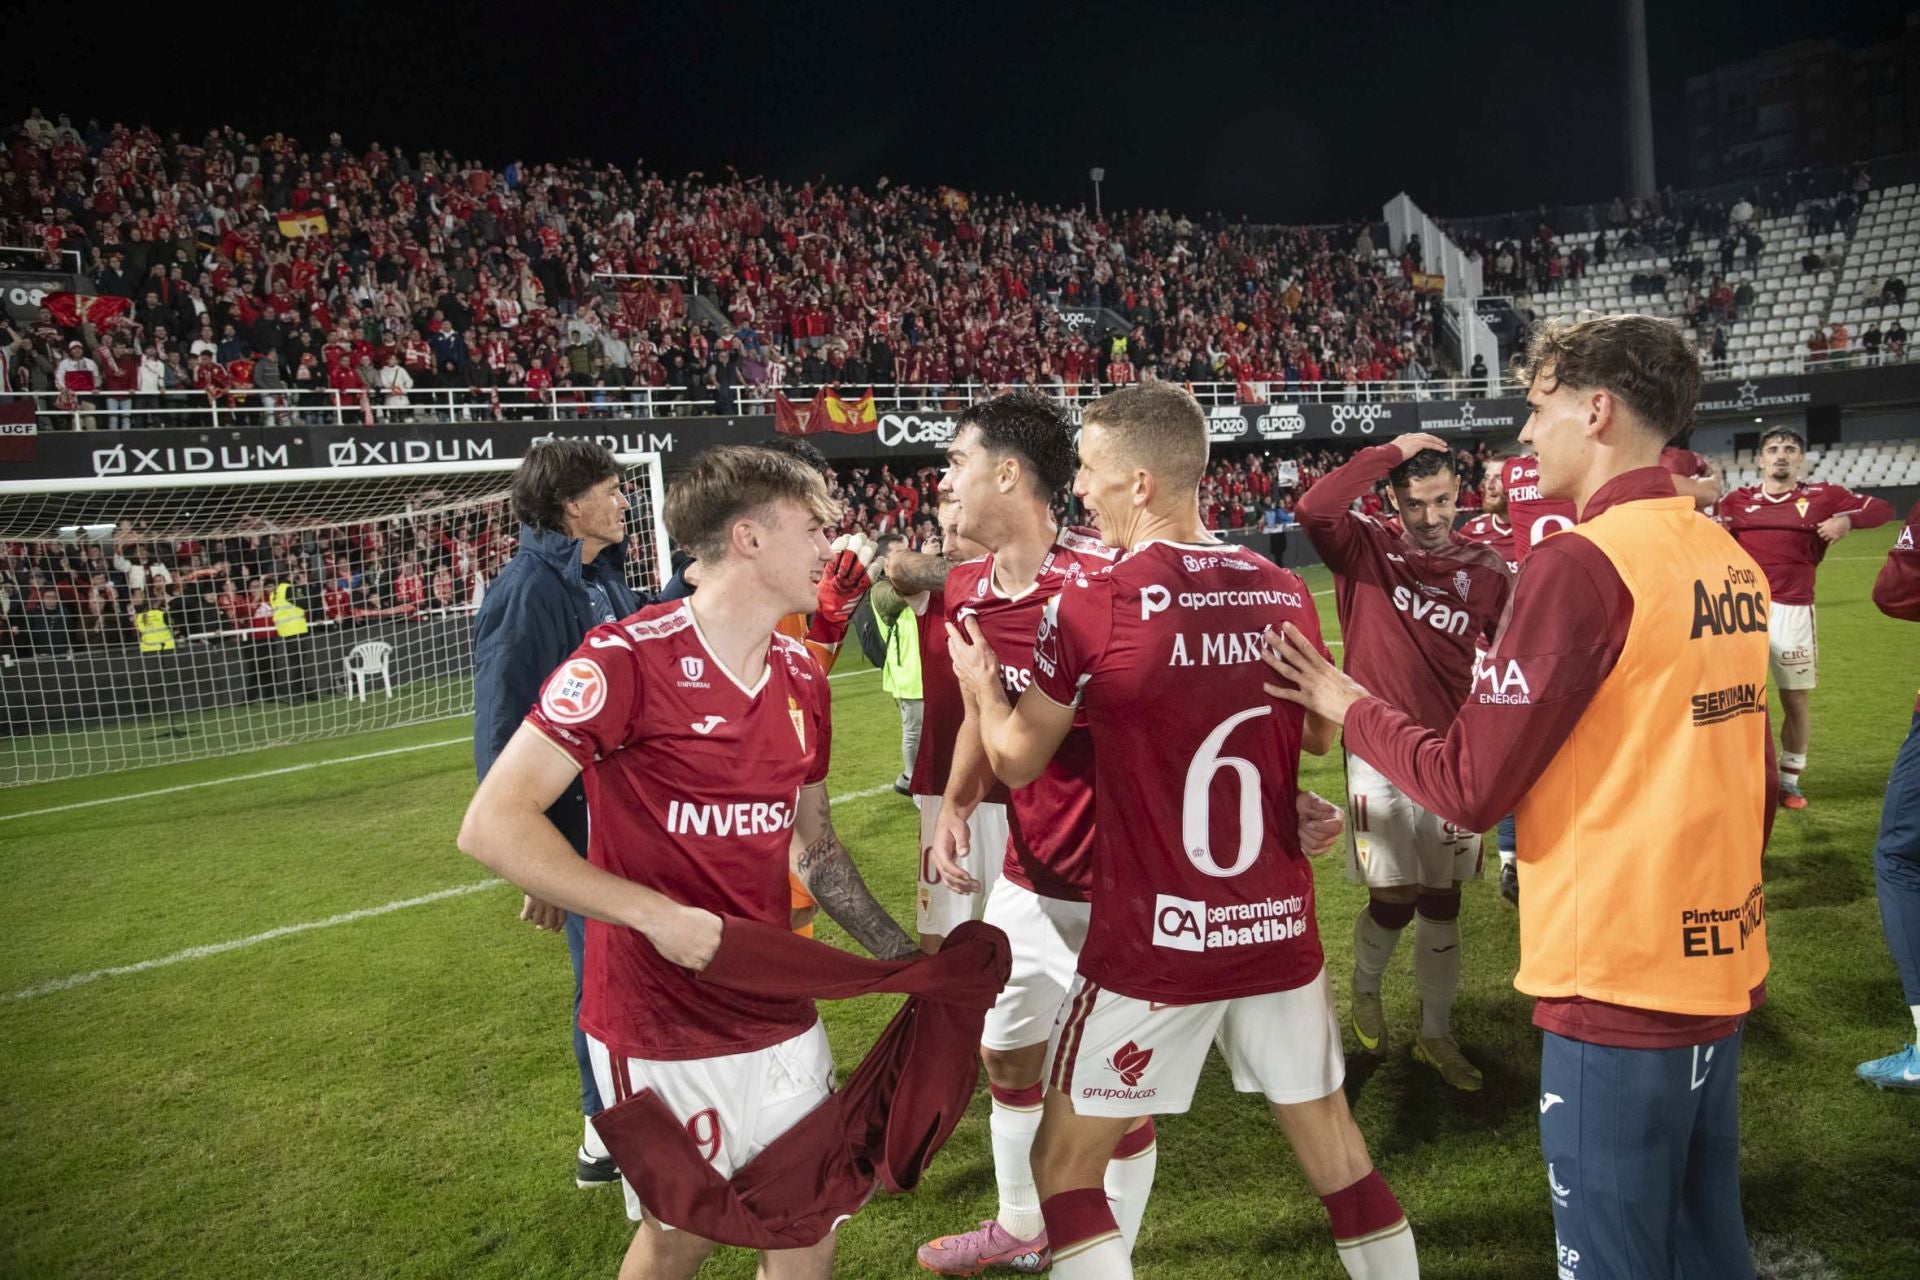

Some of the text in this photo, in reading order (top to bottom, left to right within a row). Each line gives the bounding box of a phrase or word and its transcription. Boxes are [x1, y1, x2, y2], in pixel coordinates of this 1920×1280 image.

[1421, 419, 1465, 429] ESTRELLA
[1471, 417, 1514, 427] LEVANTE
[1727, 565, 1758, 588] Grup
[1392, 586, 1469, 636] svan
[1168, 633, 1196, 667] A.
[1480, 692, 1530, 705] ENERGÍA
[1182, 705, 1273, 877] 6
[1158, 906, 1202, 941] CA
[1683, 926, 1734, 957] EL
[1082, 1087, 1158, 1100] grupolucas
